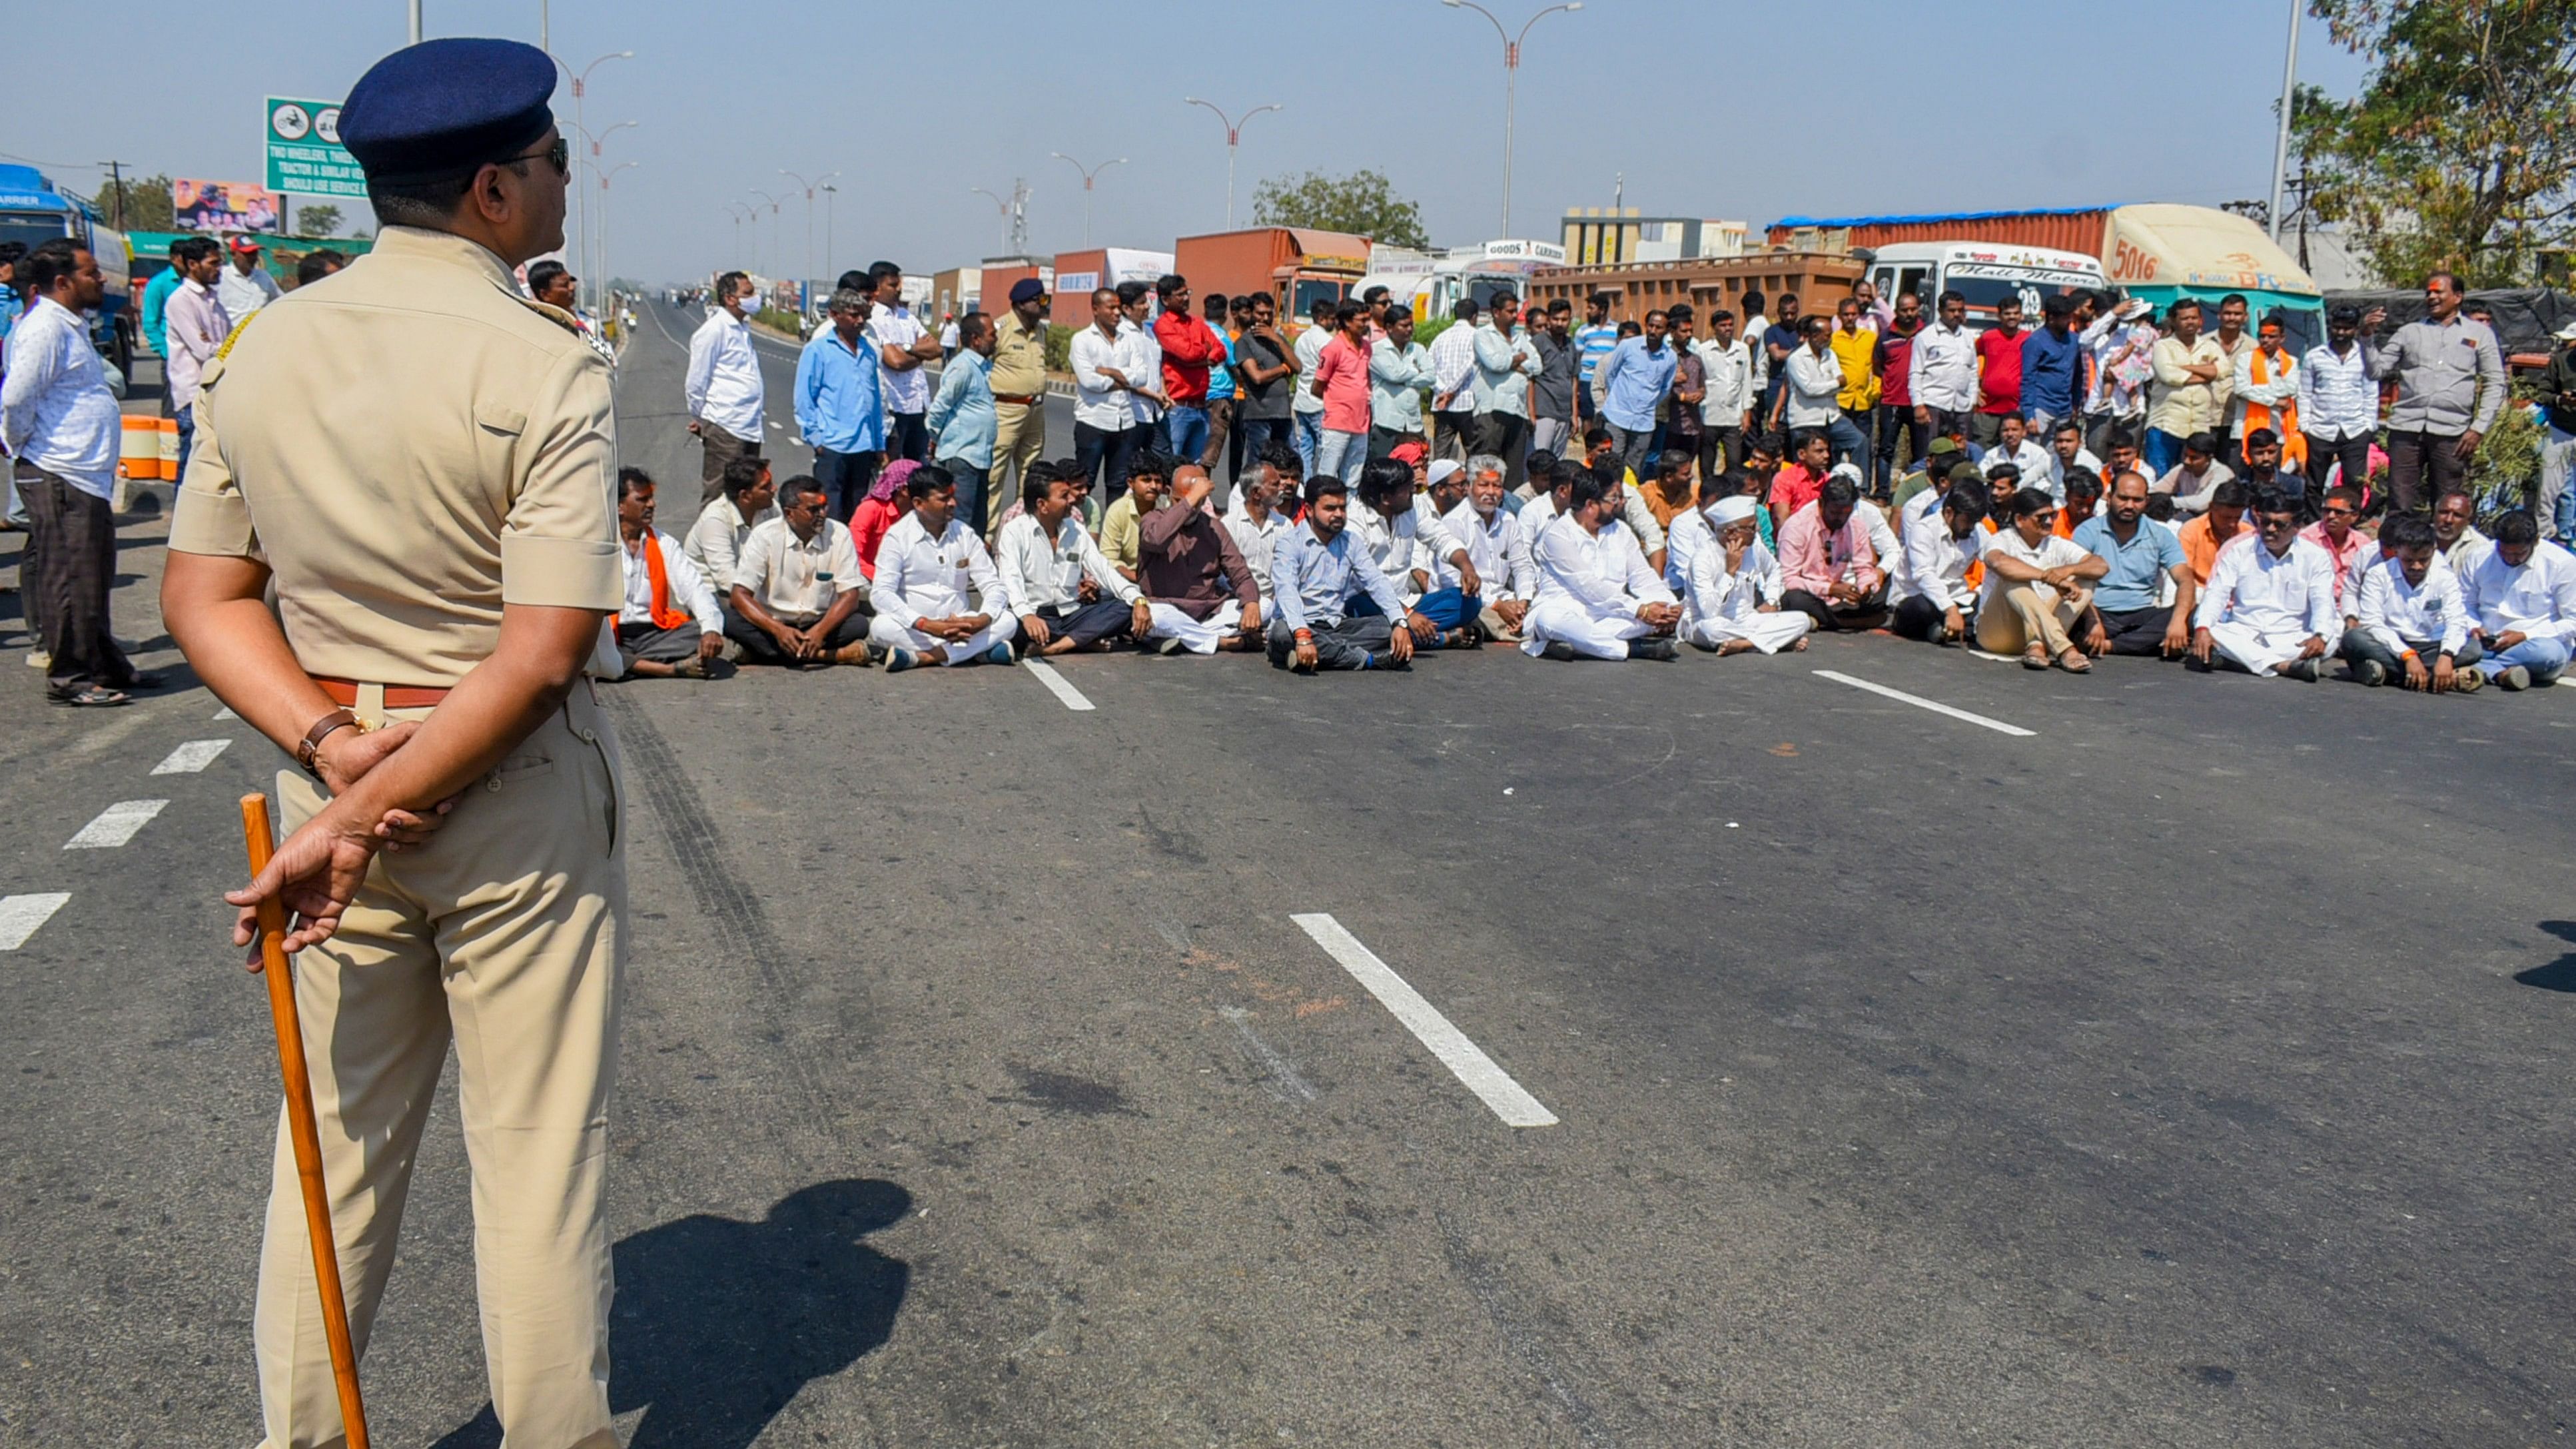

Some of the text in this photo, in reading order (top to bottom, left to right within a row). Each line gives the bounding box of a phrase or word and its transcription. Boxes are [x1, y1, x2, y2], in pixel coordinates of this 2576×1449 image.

[269, 146, 286, 158] TWO
[278, 161, 312, 176] TRACTOR
[313, 165, 320, 176] &
[320, 165, 350, 179] SIMILAR
[283, 177, 312, 191] SHOULD
[313, 179, 328, 192] USE
[329, 181, 360, 195] SERVICE
[1490, 244, 1521, 254] GOODS
[2113, 239, 2158, 280] 5016
